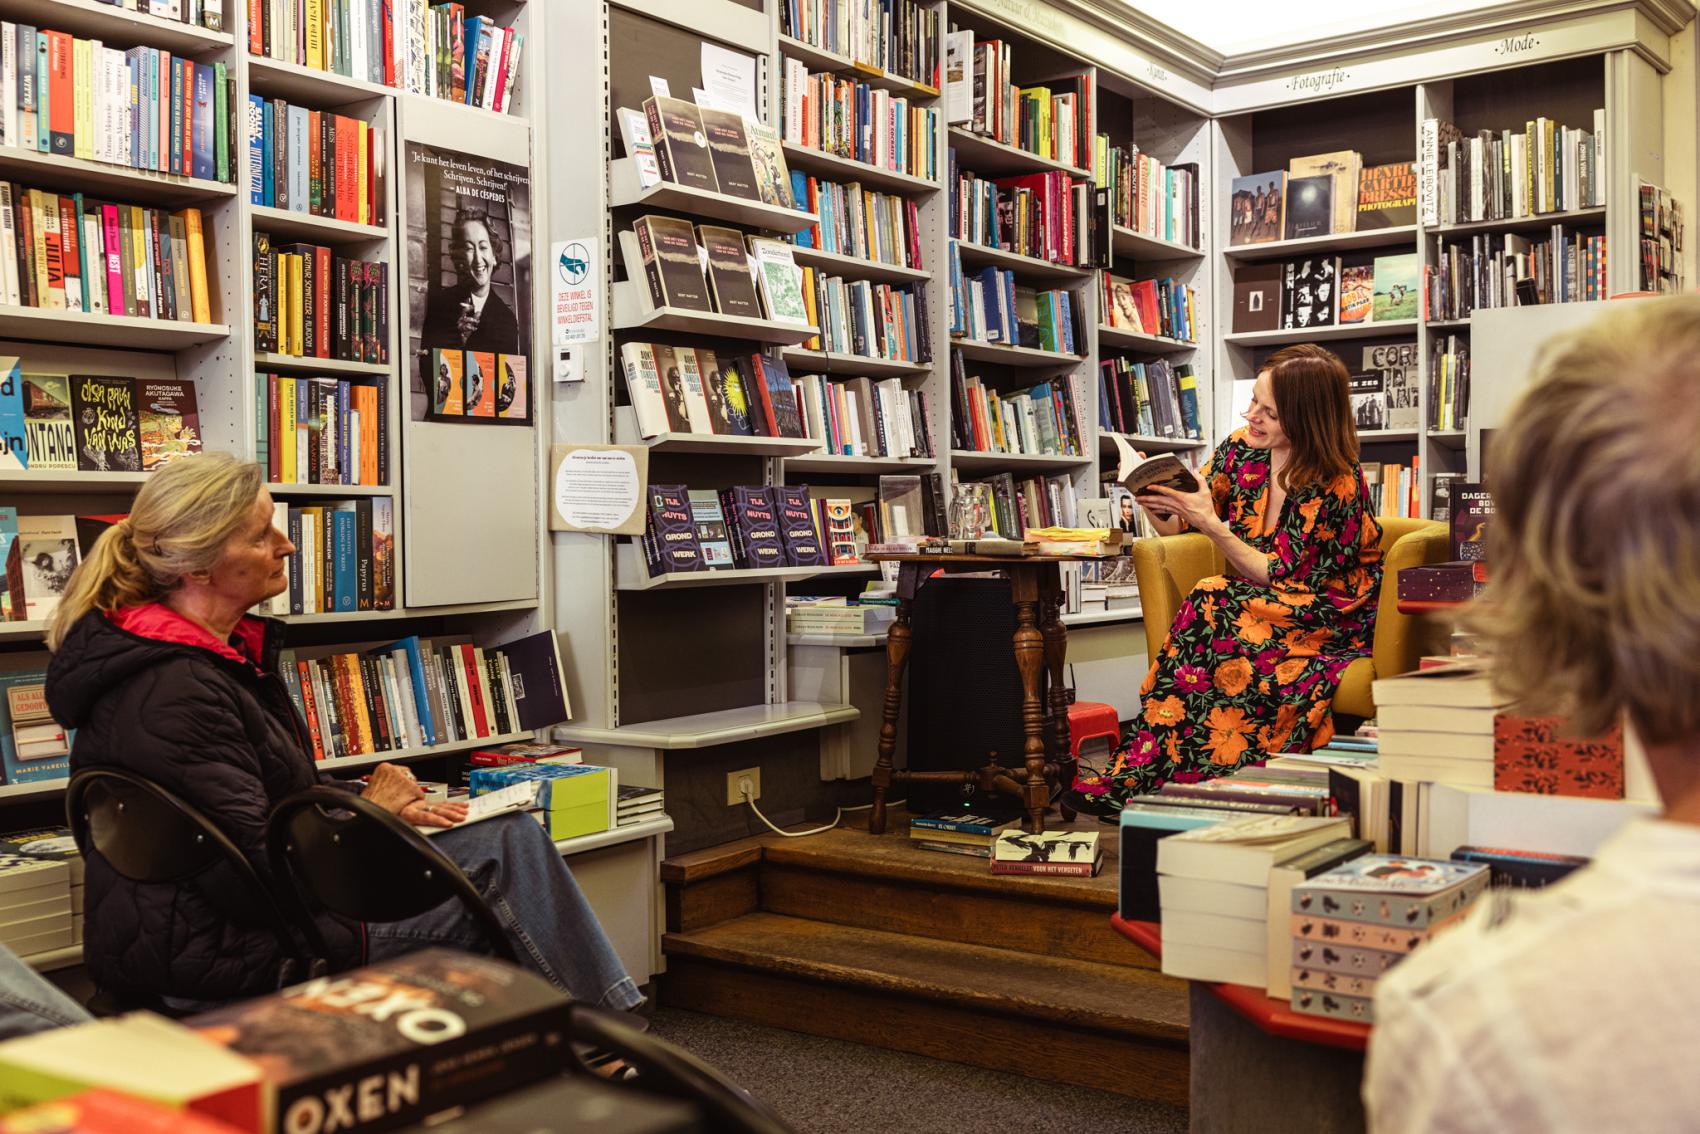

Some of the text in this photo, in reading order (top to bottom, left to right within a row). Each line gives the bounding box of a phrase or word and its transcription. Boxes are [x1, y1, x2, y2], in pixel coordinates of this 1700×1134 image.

[1494, 32, 1528, 55] Mode
[1285, 66, 1338, 92] Fotografie
[24, 74, 34, 104] WITTE
[249, 101, 257, 144] ROONEY
[1579, 143, 1587, 160] JOHN
[250, 146, 262, 192] INTERMEZZO
[421, 153, 438, 165] kunt
[438, 156, 450, 168] het
[450, 159, 466, 171] leven
[486, 167, 494, 176] of
[493, 168, 503, 178] het
[1360, 163, 1409, 181] HENRI
[1426, 130, 1434, 214] ANNIE LEIBOVITZ
[443, 169, 475, 185] Schrijven.
[1359, 174, 1417, 192] CARTIE
[455, 186, 505, 204] ALBA DE CÉSPEDES
[1359, 186, 1417, 204] BRESSO
[36, 237, 46, 275] SANDWICH
[45, 237, 62, 283] JULIA
[260, 257, 268, 290] HERA
[157, 296, 165, 314] farm
[665, 498, 681, 506] TIJL
[750, 498, 765, 506] TIJL
[788, 498, 802, 506] TIJL
[746, 510, 771, 520] NUYTS
[785, 509, 808, 519] NUYTS
[665, 532, 692, 541] GROND
[750, 530, 776, 540] GROND
[789, 529, 812, 539] GROND
[672, 550, 696, 559] WERK
[757, 547, 778, 556] WERK
[796, 546, 816, 554] WERK
[925, 546, 942, 554] MAGGIE
[360, 559, 368, 592] Papyrus
[1032, 865, 1047, 873] VOOR
[1057, 866, 1083, 874] VERGETEN
[284, 1062, 420, 1134] OXEN
